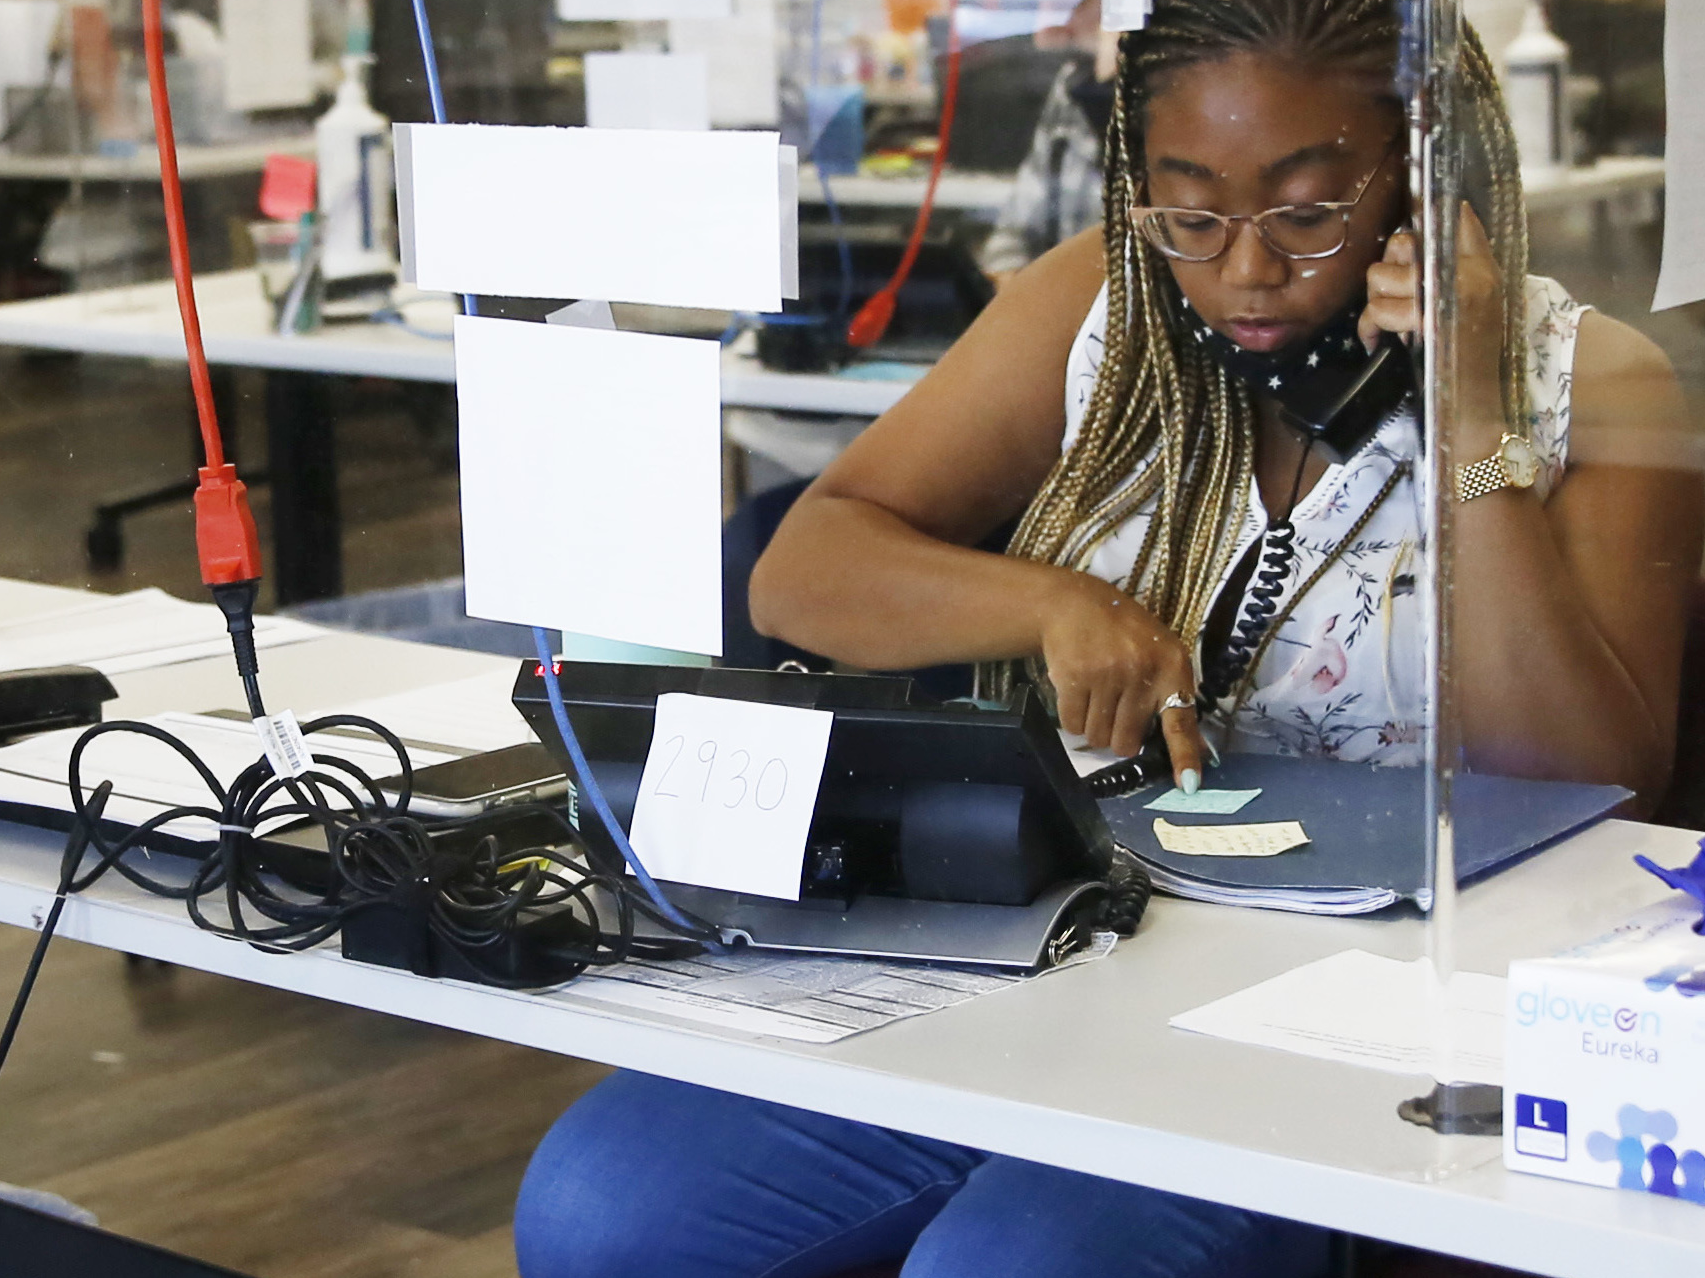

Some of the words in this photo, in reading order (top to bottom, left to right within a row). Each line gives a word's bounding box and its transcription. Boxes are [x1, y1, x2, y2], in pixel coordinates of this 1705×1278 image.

[654, 735, 788, 811] 2930
[1516, 982, 1661, 1036] gloveon
[1582, 1031, 1660, 1064] Eureka
[1533, 1102, 1550, 1128] L
